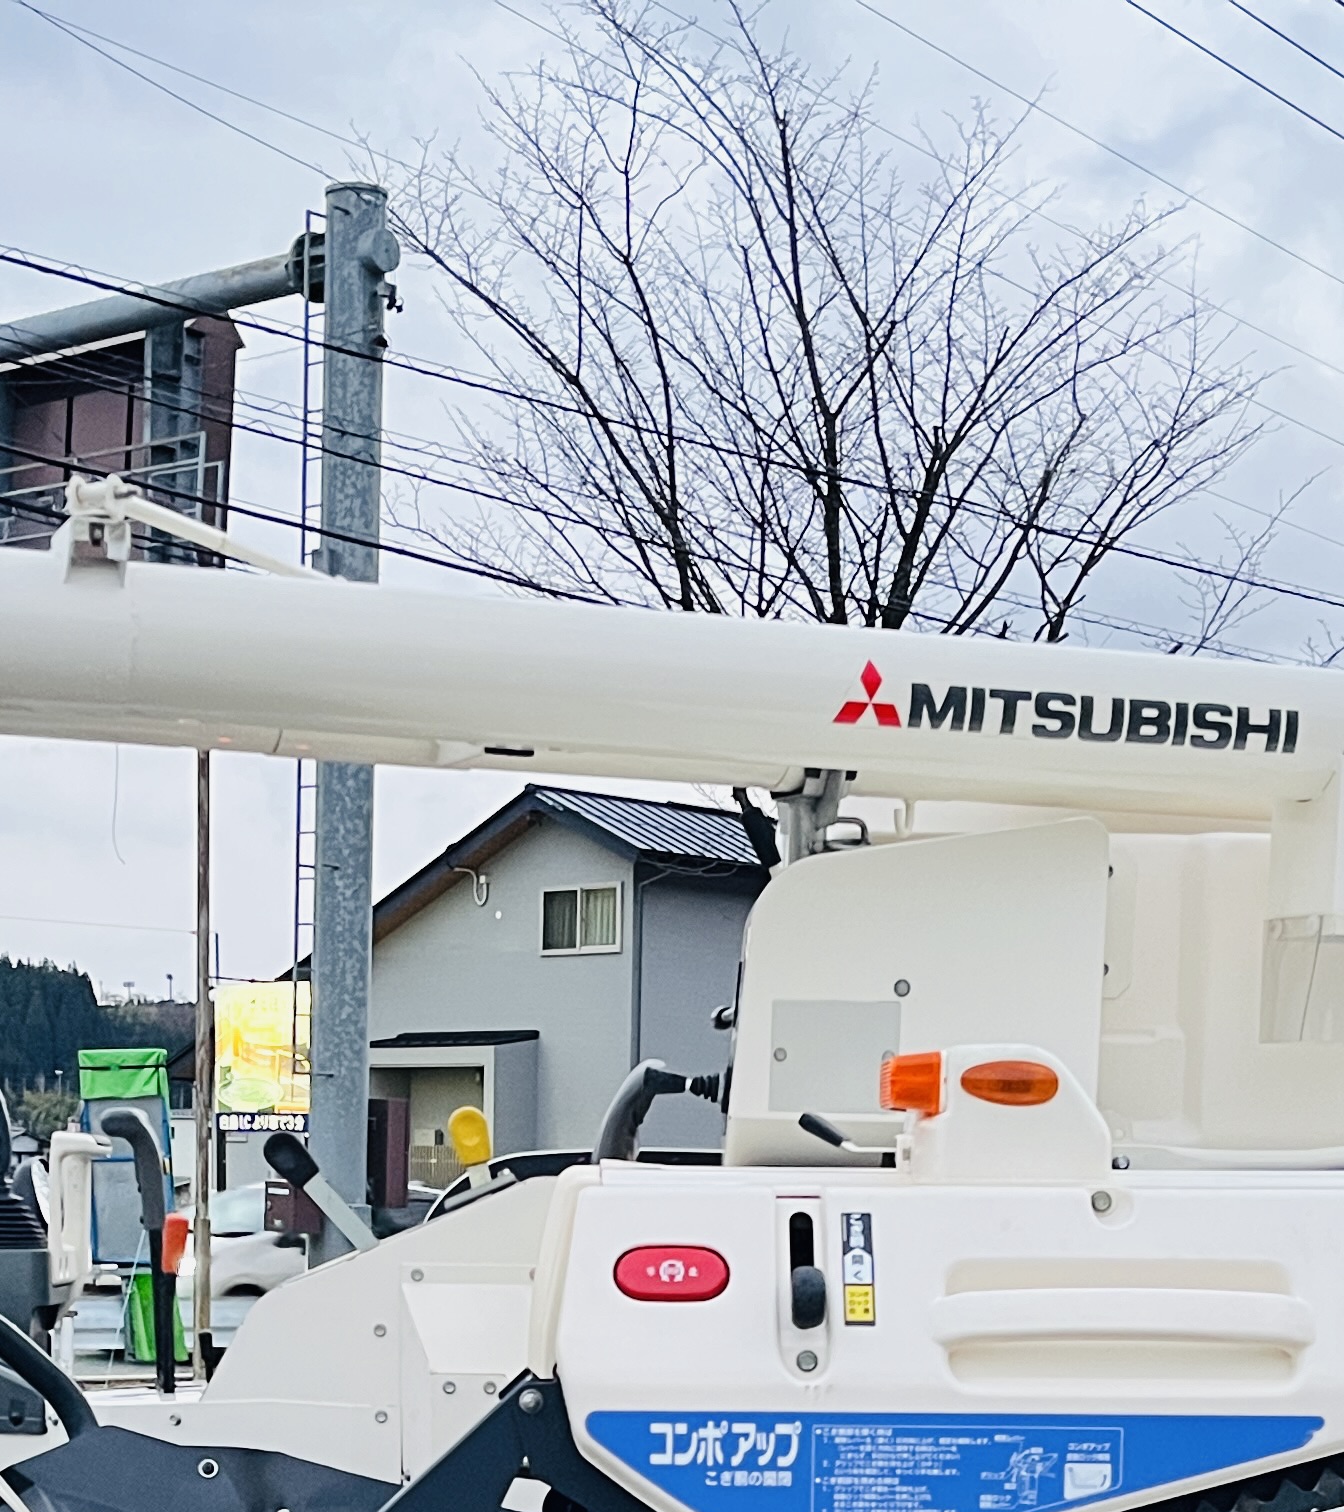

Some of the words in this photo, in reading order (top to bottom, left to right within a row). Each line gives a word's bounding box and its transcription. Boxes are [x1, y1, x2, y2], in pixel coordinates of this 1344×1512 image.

[906, 682, 1300, 754] MITSUBISHI
[649, 1420, 802, 1467] コンポアップ
